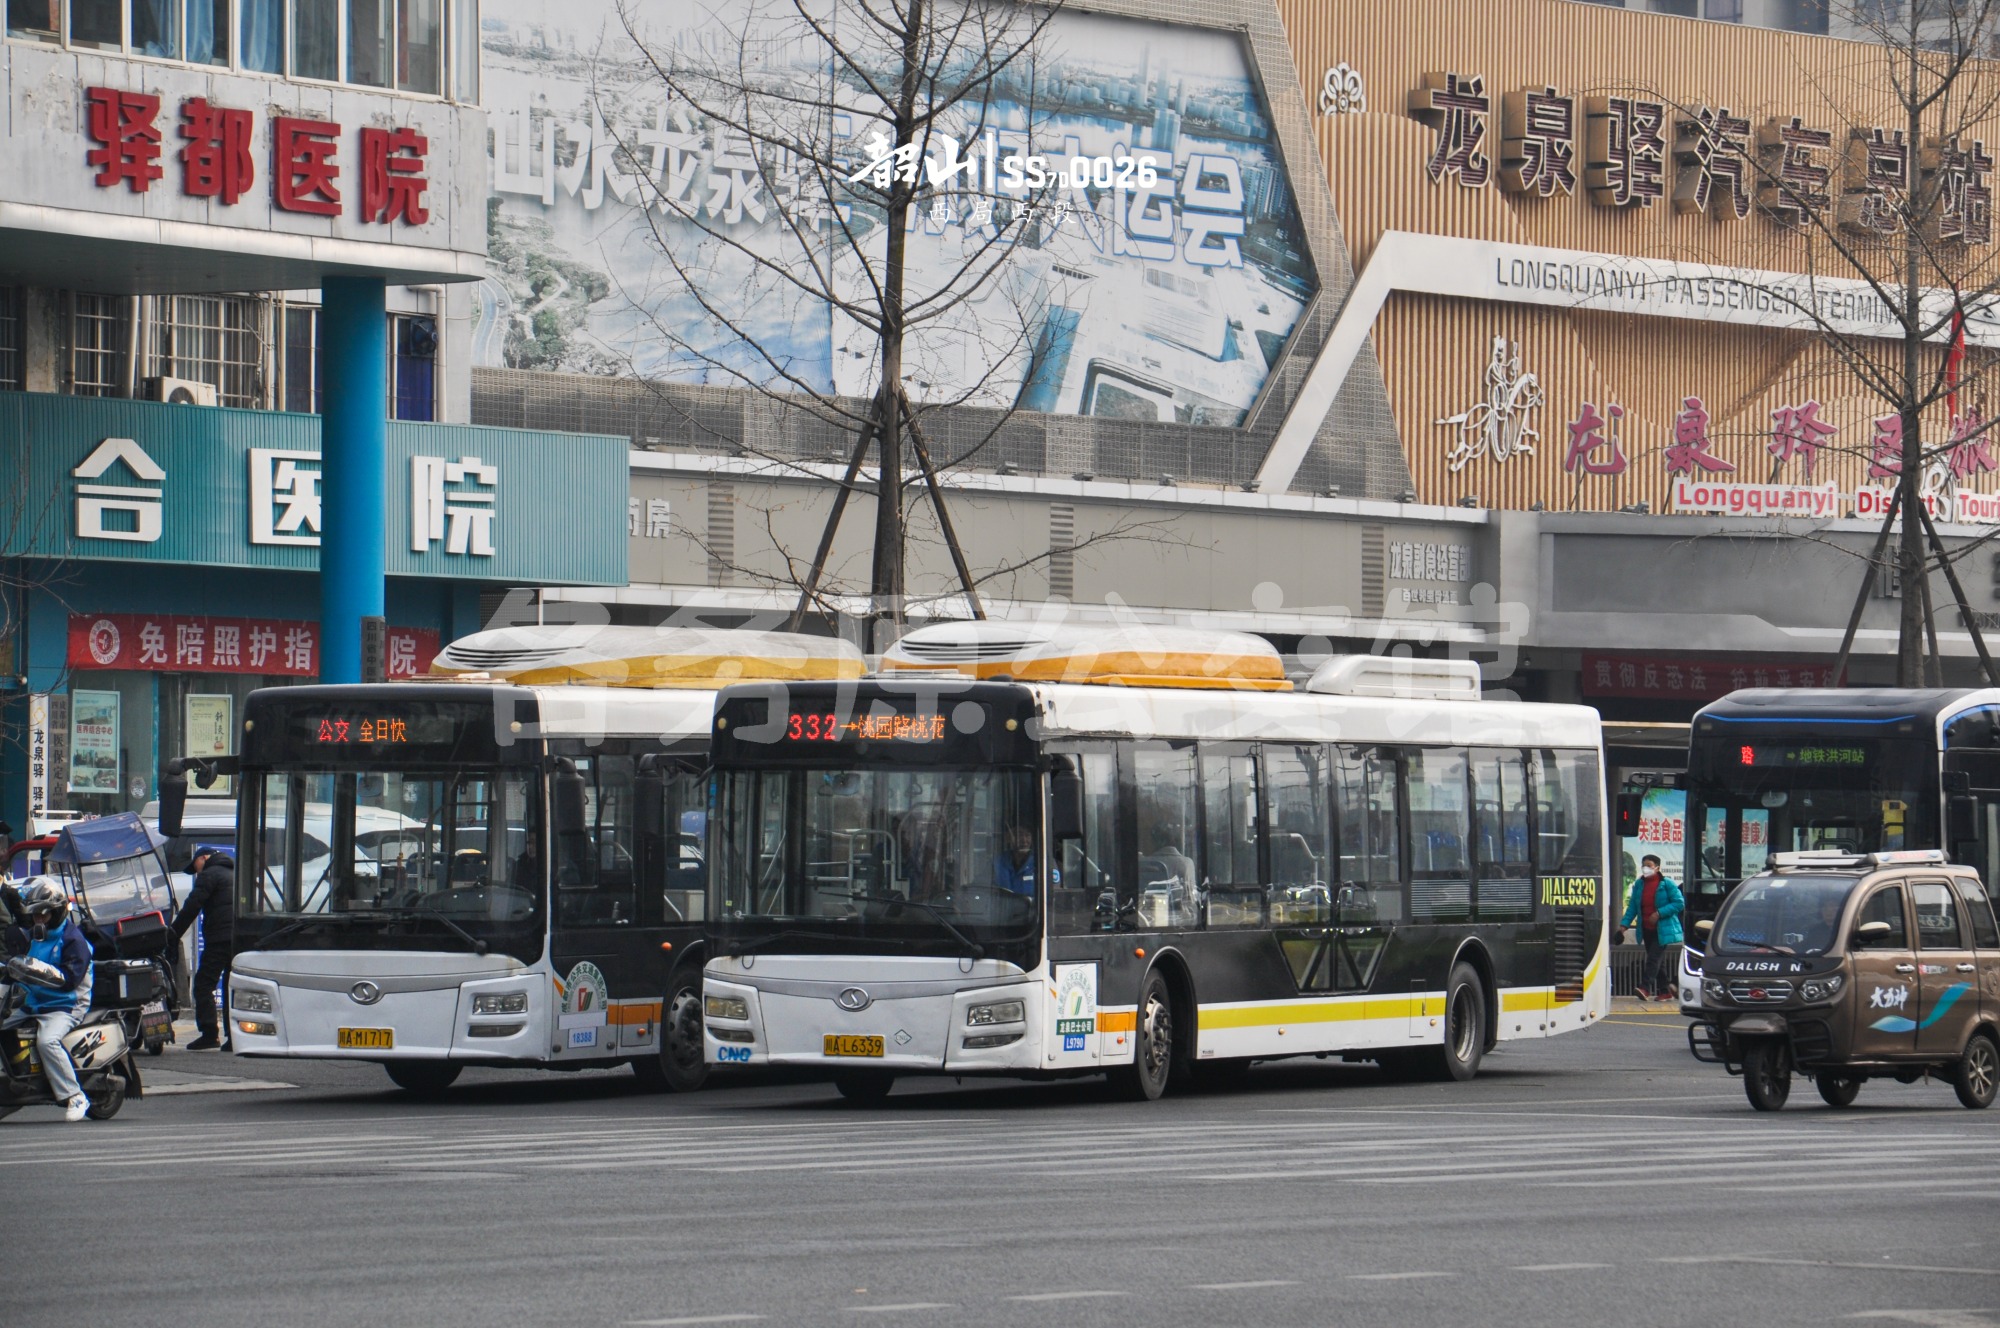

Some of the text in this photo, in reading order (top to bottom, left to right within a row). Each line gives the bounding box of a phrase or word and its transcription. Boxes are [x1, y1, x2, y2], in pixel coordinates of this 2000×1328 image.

[88, 86, 430, 226] 驿都医院
[1420, 72, 1994, 245] 龙泉驿汽车总站
[1496, 257, 1646, 300] LONGQUANYI
[1664, 274, 1797, 315] PASSENGER
[71, 437, 498, 556] 合医院
[1679, 483, 1835, 515] Longquanyi
[138, 622, 314, 670] 免陪照护指
[389, 635, 417, 675] 院
[1594, 660, 1707, 690] 贯彻反恐法
[318, 717, 407, 742] 公交 全日快
[788, 713, 838, 740] 332
[33, 729, 45, 778] 龙泉驿
[1800, 747, 1865, 764] 地铁洪河站
[1637, 818, 1684, 843] 关注食品
[1541, 877, 1596, 906] 川AL6339
[1726, 961, 1780, 972] DALISH
[1869, 985, 1909, 1012] 大力神
[1066, 1037, 1084, 1050] L9790
